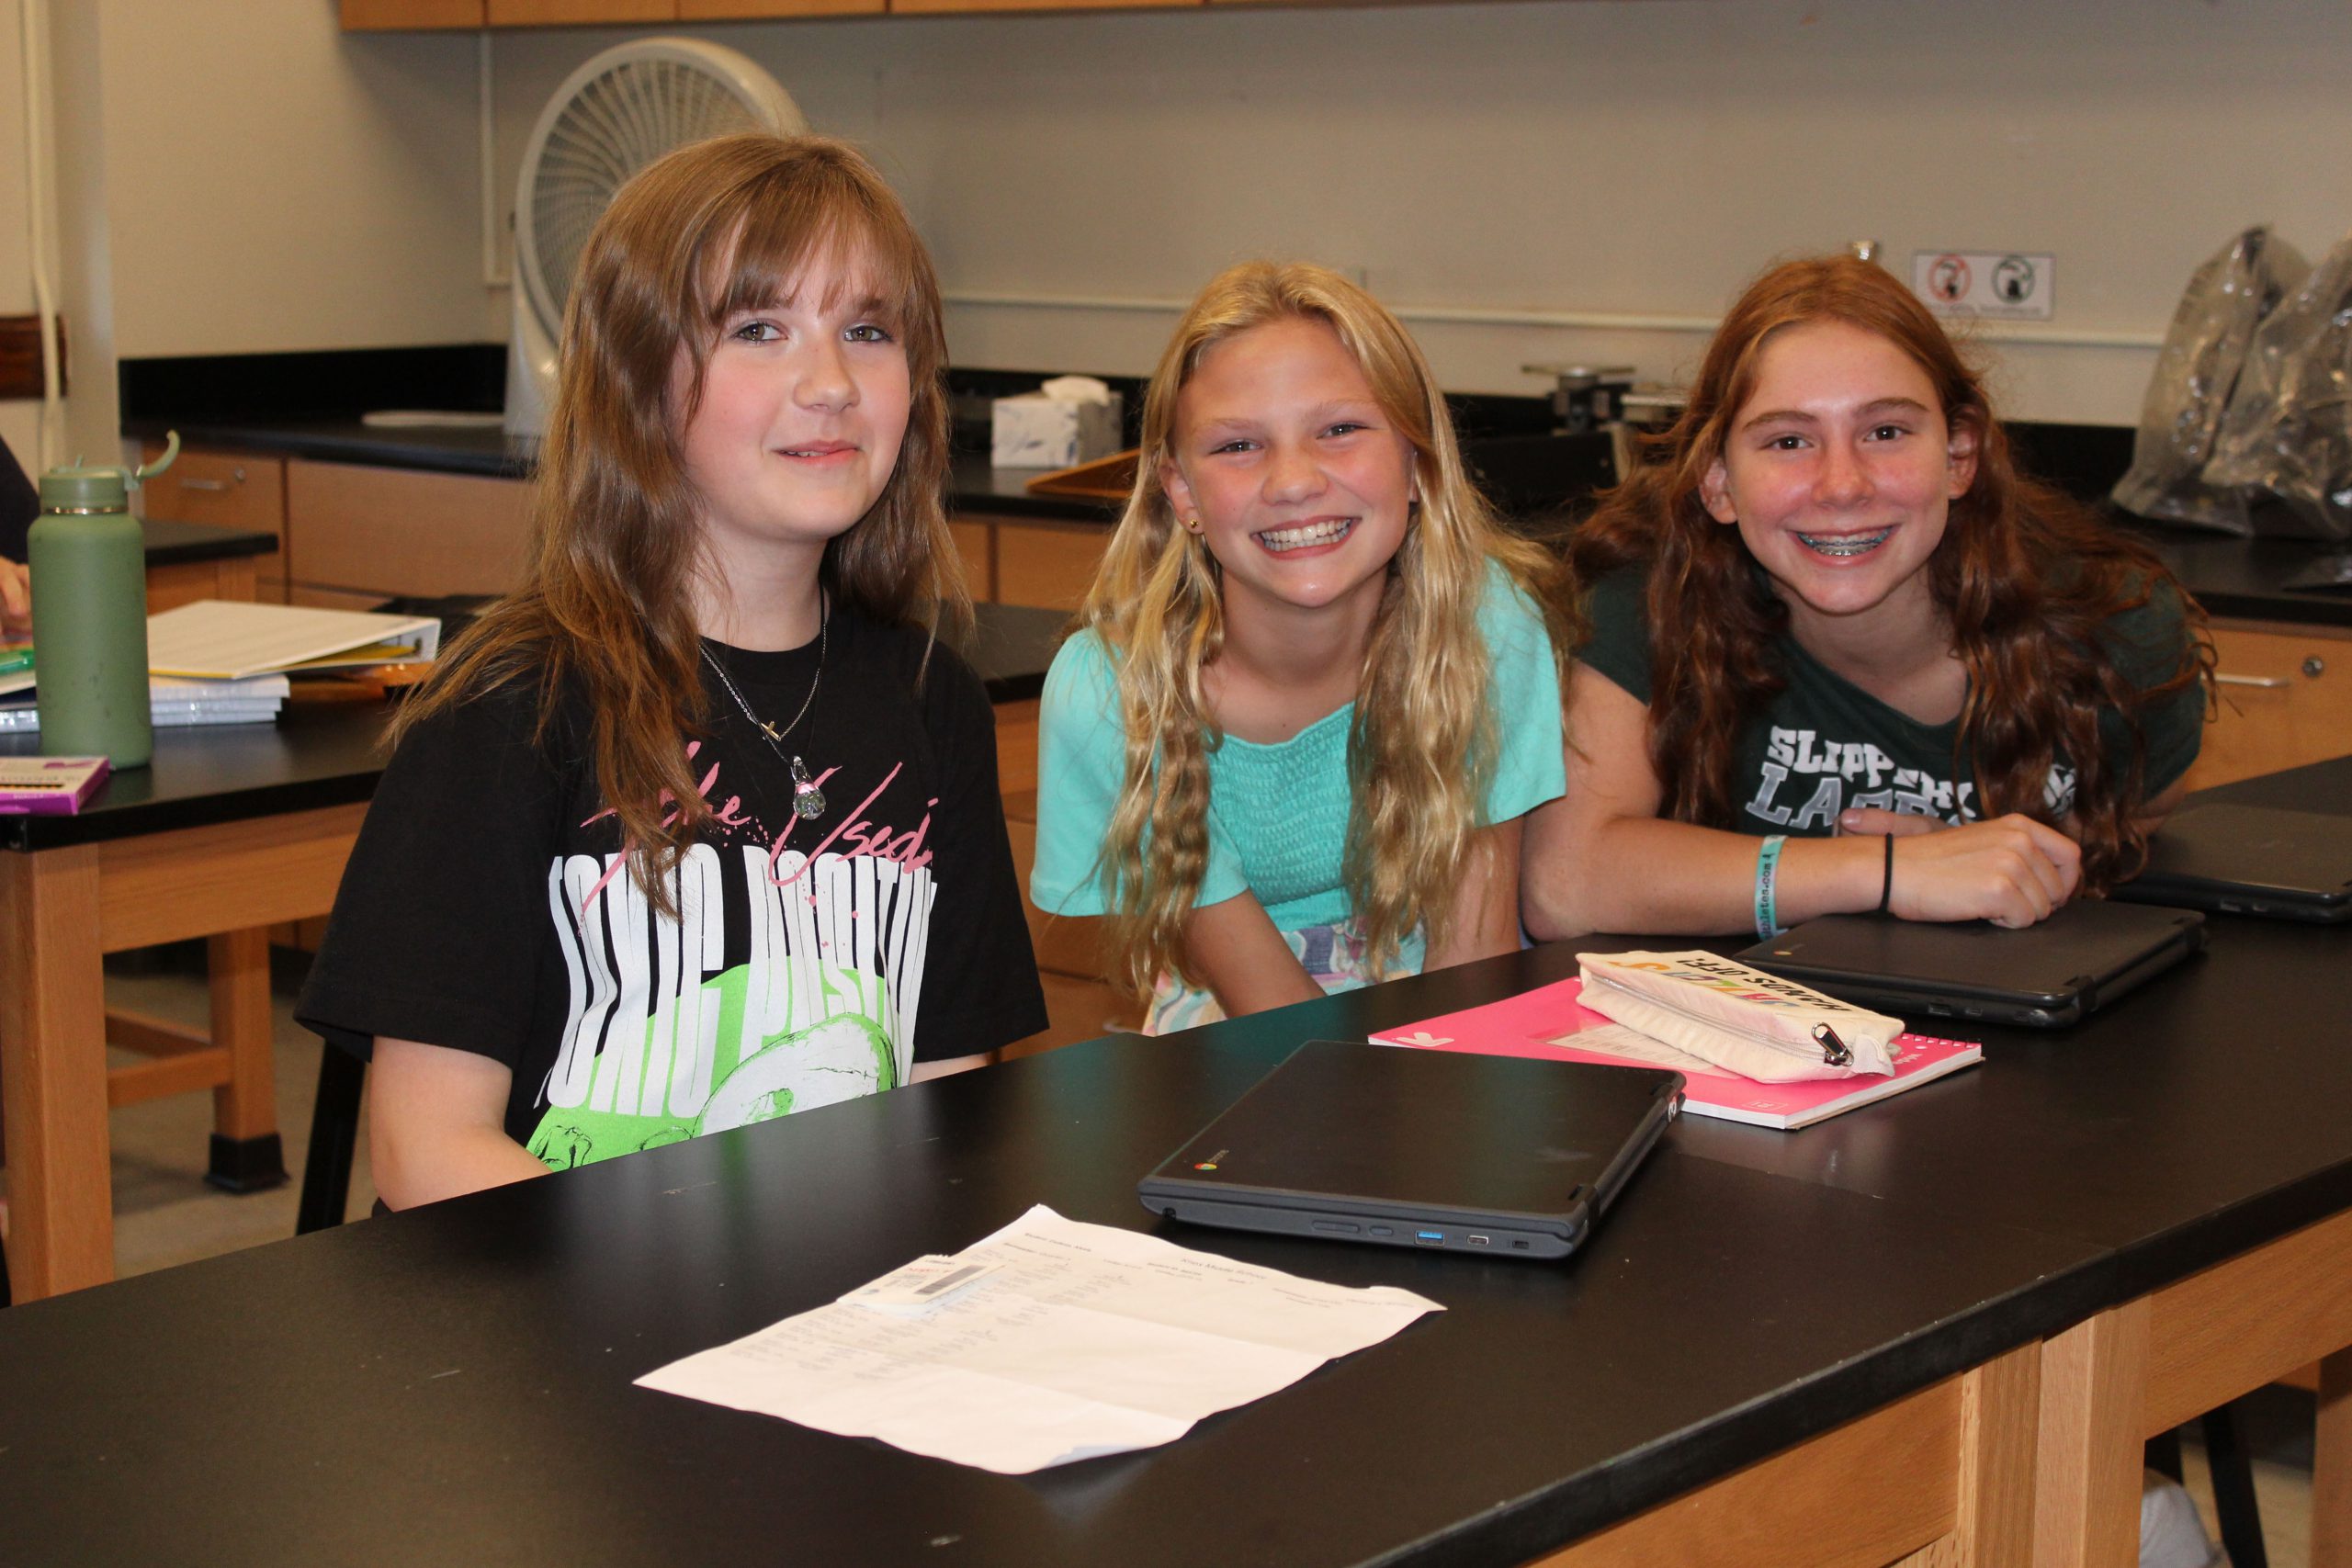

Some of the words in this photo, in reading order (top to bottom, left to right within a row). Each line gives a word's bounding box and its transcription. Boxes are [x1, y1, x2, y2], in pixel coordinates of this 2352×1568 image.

[768, 761, 939, 886] Used
[1677, 958, 1750, 976] OFF!
[1743, 977, 1853, 1011] HANDS
